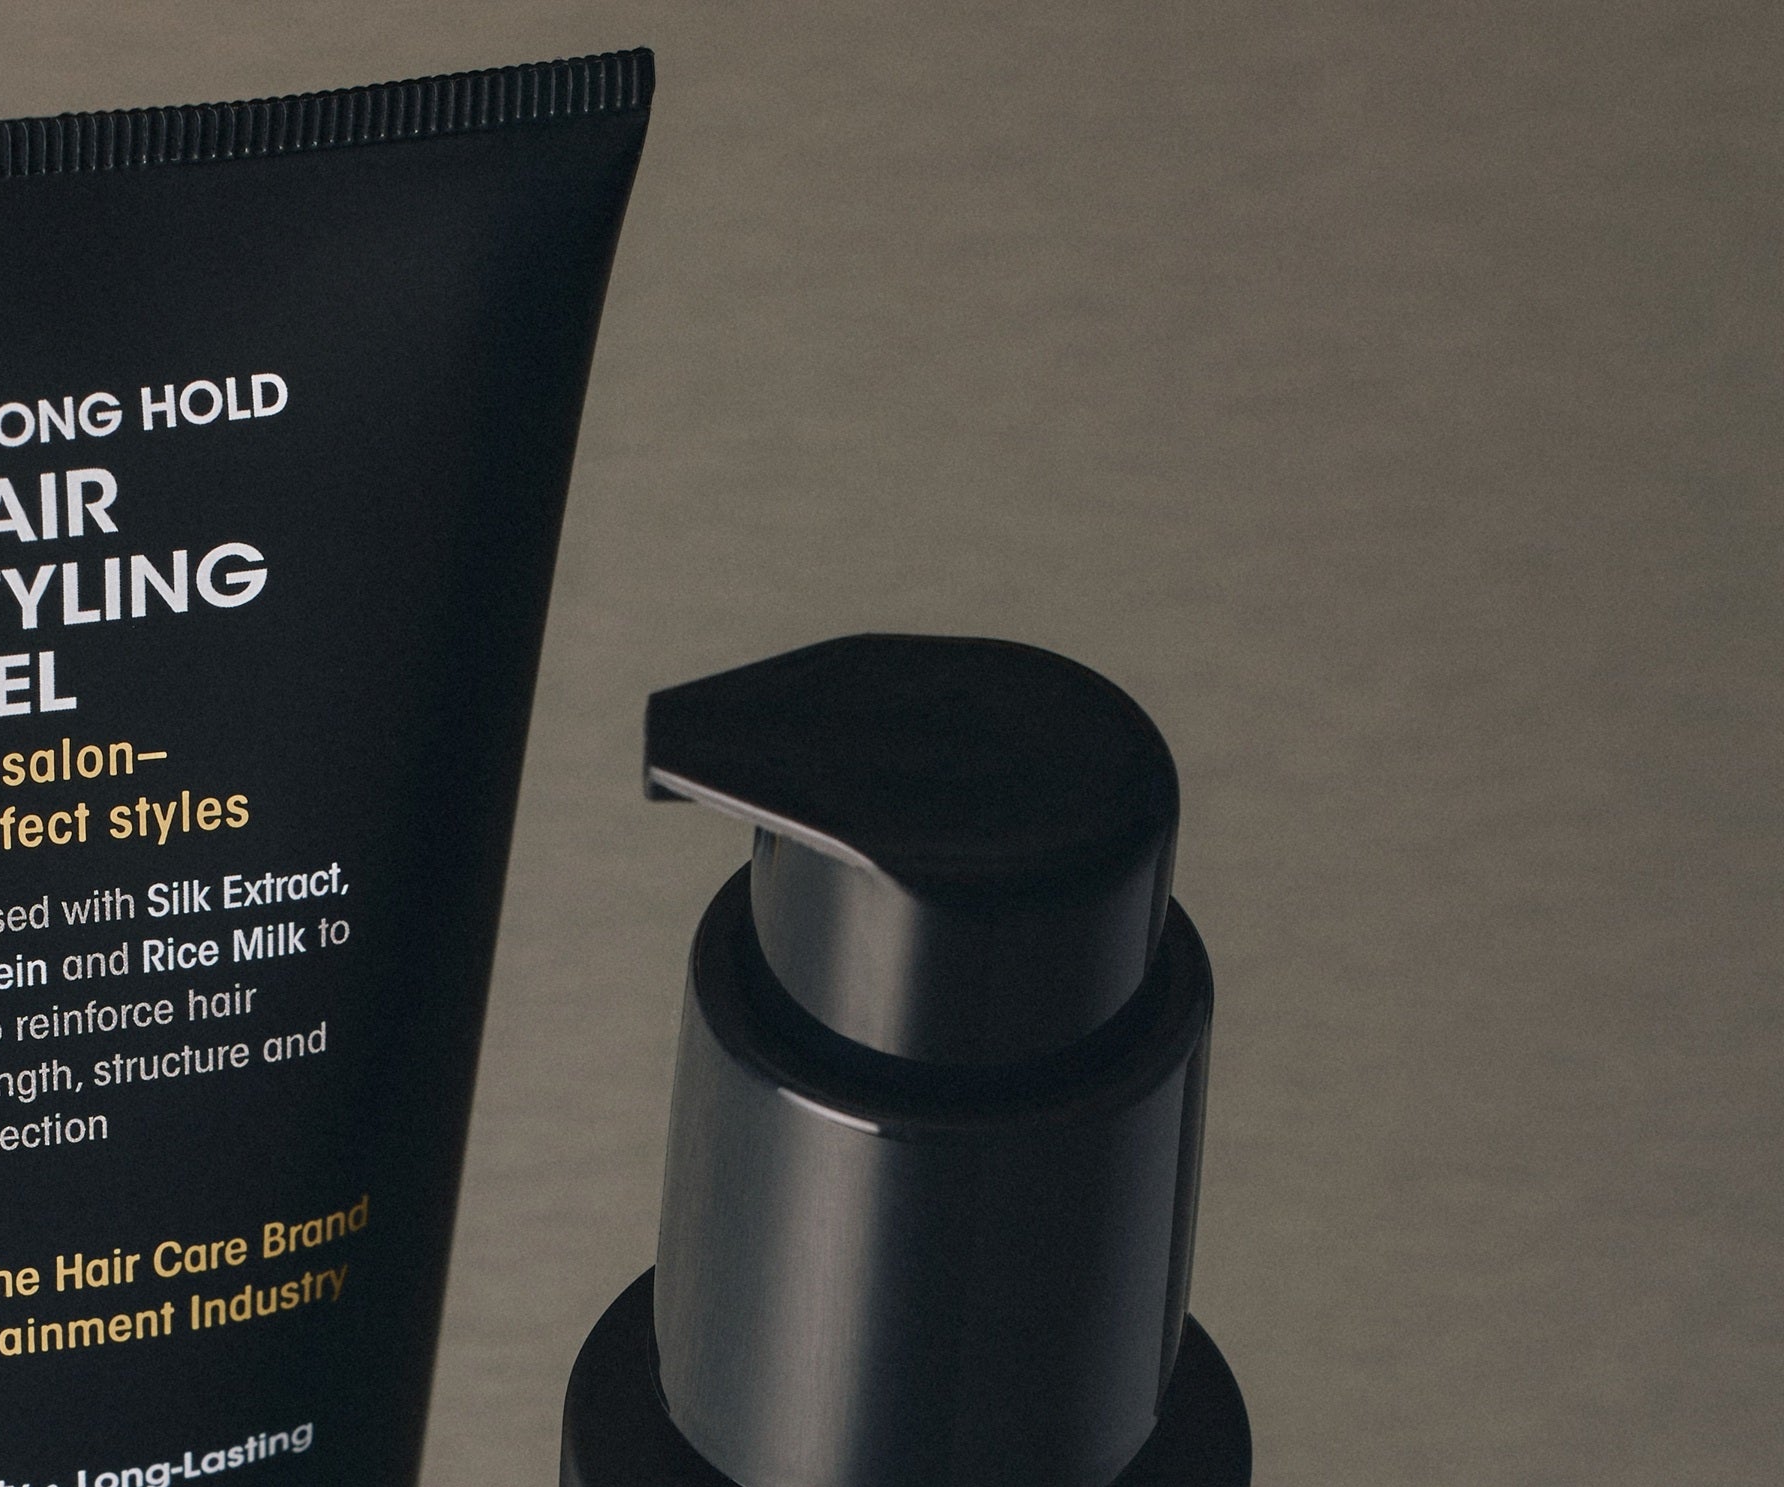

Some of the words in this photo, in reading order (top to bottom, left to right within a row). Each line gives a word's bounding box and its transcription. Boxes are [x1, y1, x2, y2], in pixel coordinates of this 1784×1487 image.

[140, 372, 289, 431] HOLD
[2, 737, 168, 787] salon–
[109, 790, 250, 846] styles
[61, 887, 135, 926] with
[147, 879, 212, 918] Silk
[223, 861, 349, 910] Extract,
[62, 941, 129, 982] and
[142, 936, 220, 974] Rice
[232, 921, 307, 963] Milk
[317, 917, 351, 948] to
[16, 999, 174, 1042] reinforce
[188, 982, 258, 1022] hair
[93, 1043, 250, 1087] structure
[262, 1020, 327, 1063] and
[55, 1248, 141, 1292] Hair
[153, 1230, 249, 1278] Care
[263, 1195, 370, 1260] Brand
[191, 1261, 350, 1332] Industry
